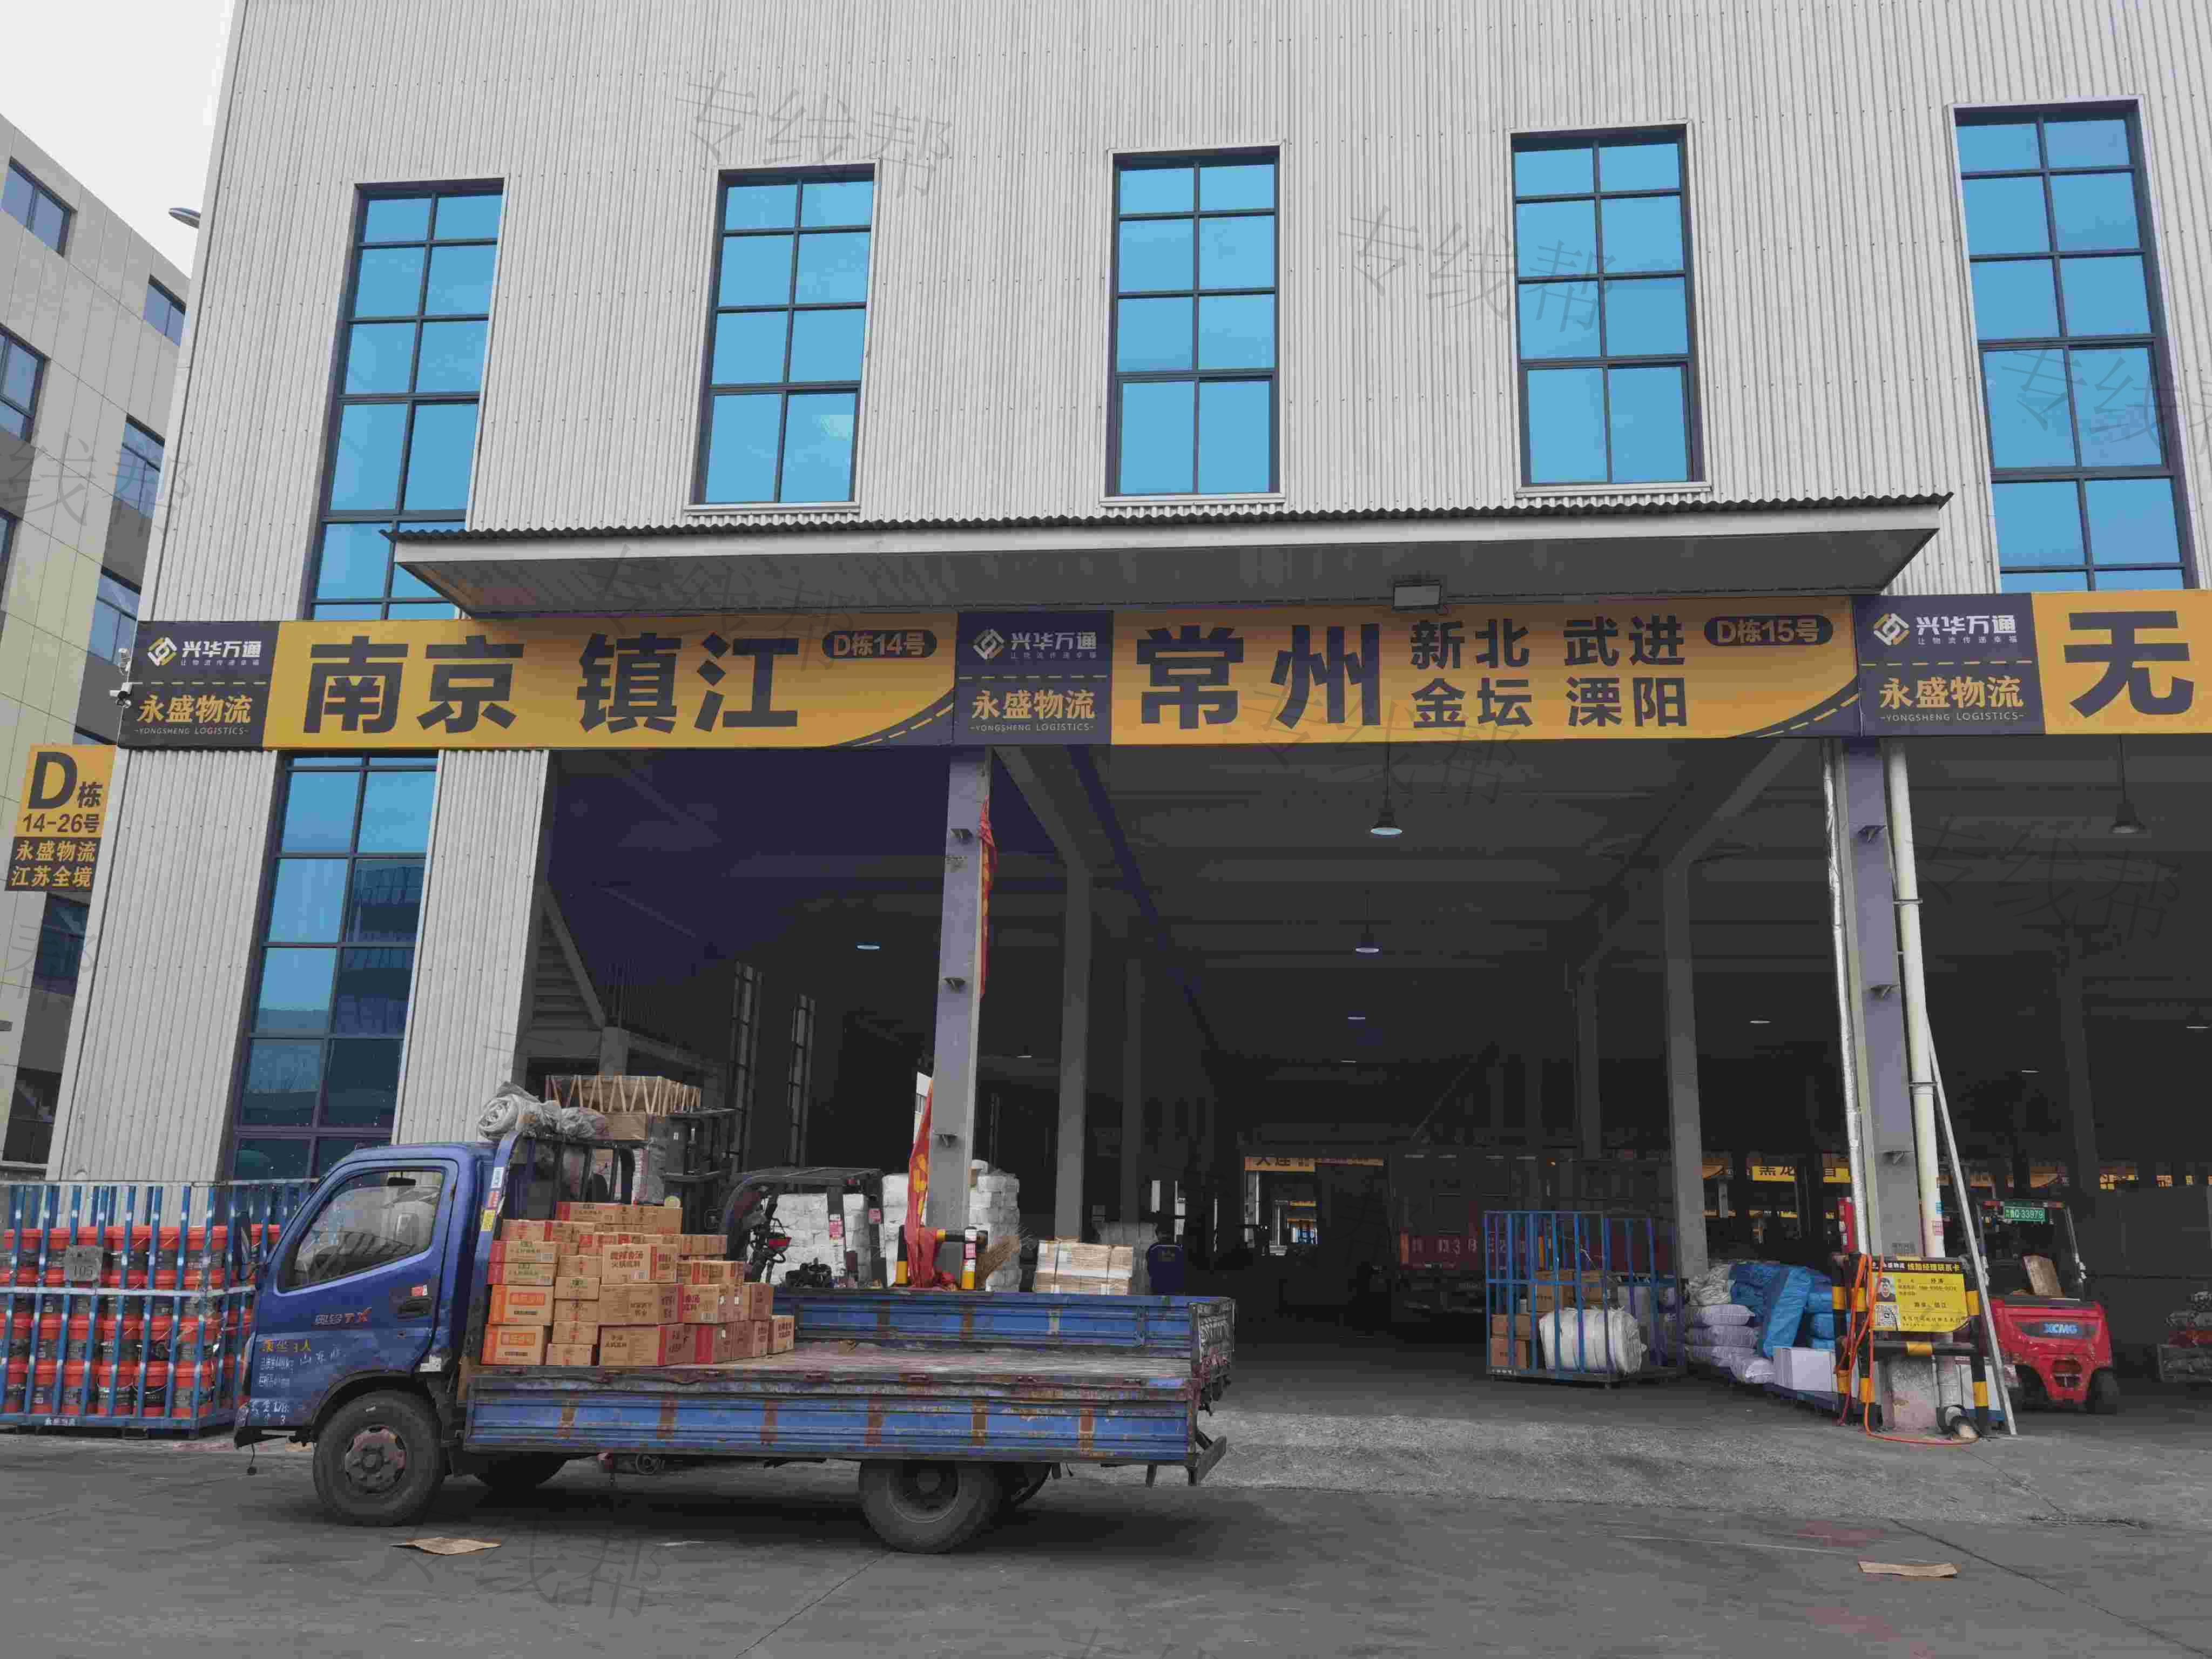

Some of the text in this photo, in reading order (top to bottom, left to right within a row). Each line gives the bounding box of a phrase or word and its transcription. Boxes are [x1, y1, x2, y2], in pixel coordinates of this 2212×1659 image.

[1717, 617, 1820, 644] D栋15号
[1916, 615, 2018, 635] 兴华万通
[183, 639, 262, 659] 兴华万通
[833, 633, 925, 657] D栋14号
[1010, 631, 1097, 651] 兴华万通
[1410, 614, 1686, 670] 新北 武进
[2063, 609, 2195, 719] 无
[303, 632, 799, 735] 南京 镇江
[1136, 623, 1381, 730] 常州
[1411, 676, 1689, 729] 金坛 溧阳
[1879, 675, 2024, 710] 永盛物流
[137, 694, 253, 724] 永盛物流
[972, 689, 1095, 721] 永盛物流
[1886, 712, 2019, 722] YONGSHENG LOGISTICS
[194, 727, 245, 735] LOGISTICS
[975, 723, 1089, 732] YONGSHENG LOGISTICS
[22, 813, 100, 834] 14-26号
[16, 840, 96, 863] 永盛物流
[11, 865, 93, 889] 江苏全境
